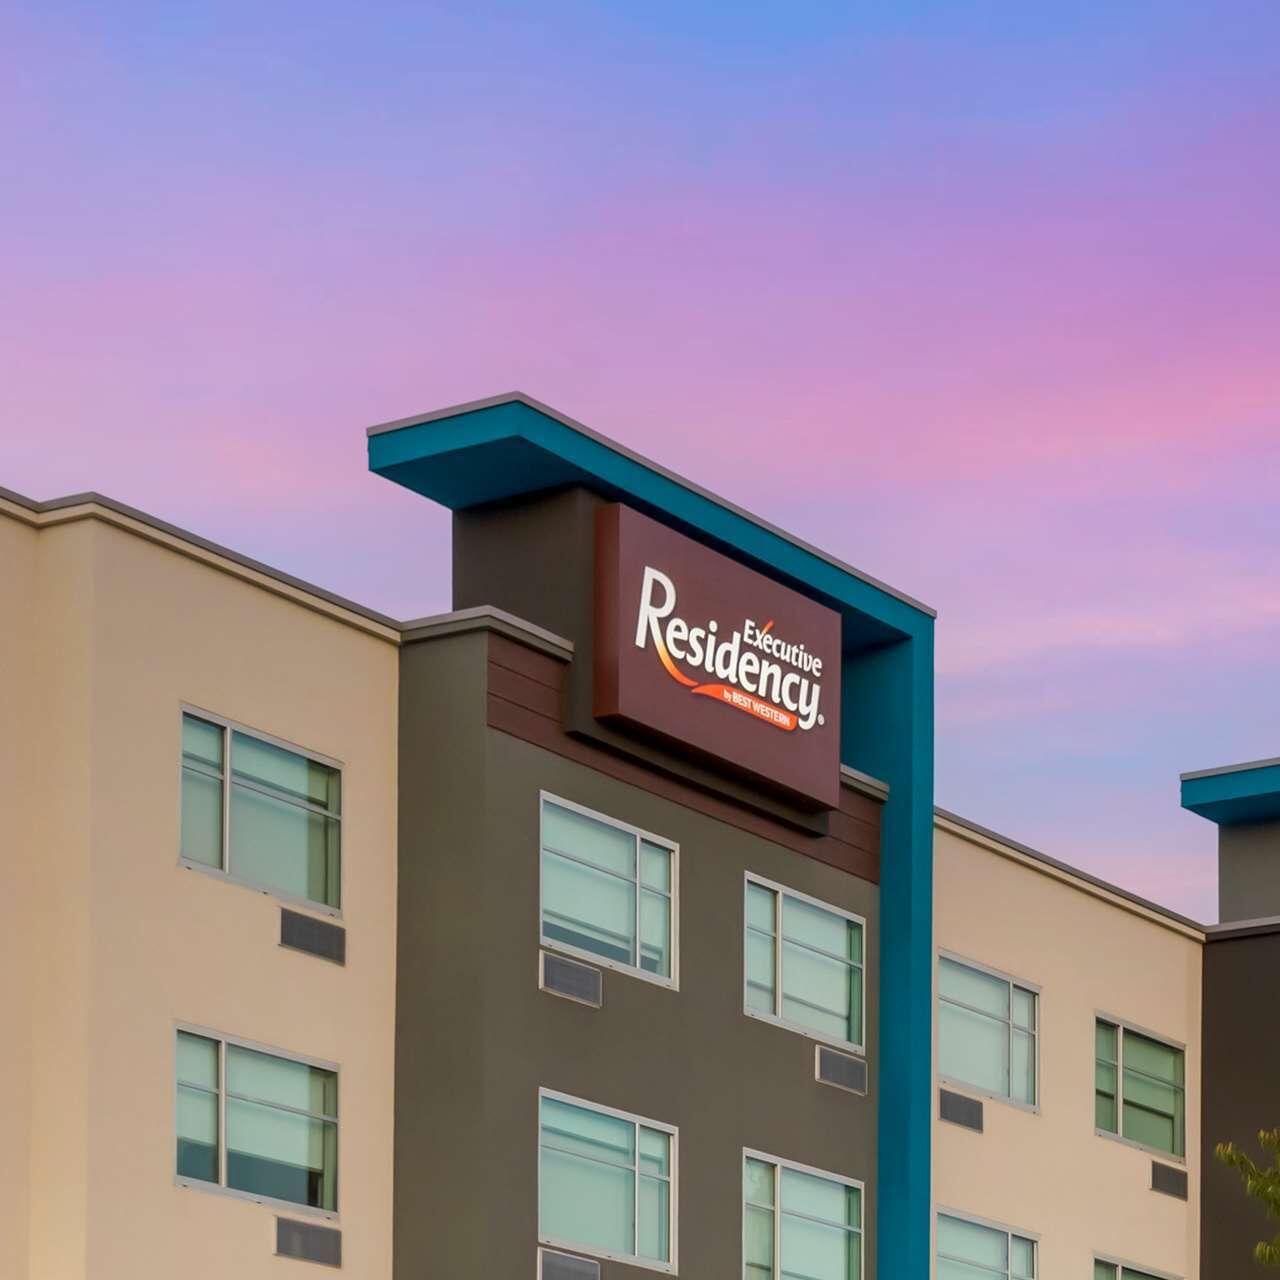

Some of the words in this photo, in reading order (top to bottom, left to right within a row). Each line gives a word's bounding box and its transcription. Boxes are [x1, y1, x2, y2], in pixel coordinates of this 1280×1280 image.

[743, 618, 822, 677] Executive
[732, 691, 752, 709] BEST
[752, 700, 791, 727] WESTERN
